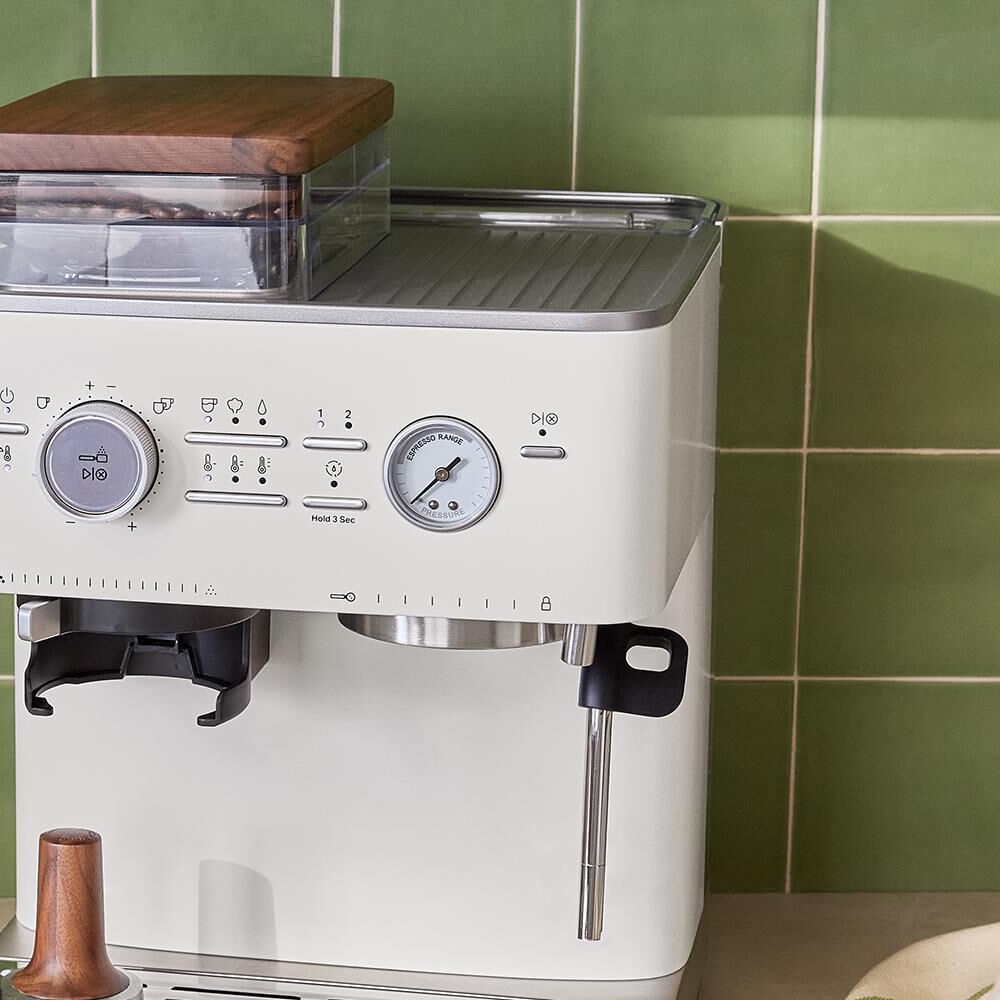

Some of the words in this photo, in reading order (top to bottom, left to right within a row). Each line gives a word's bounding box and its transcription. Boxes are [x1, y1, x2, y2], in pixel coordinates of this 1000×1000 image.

[318, 409, 323, 418] 1
[345, 409, 352, 419] 2
[406, 434, 436, 462] ESPRESSO
[438, 433, 464, 446] RANGE
[421, 506, 465, 518] PRESSURE
[311, 515, 331, 523] Hold
[332, 515, 338, 523] 3
[339, 515, 356, 524] Sec
